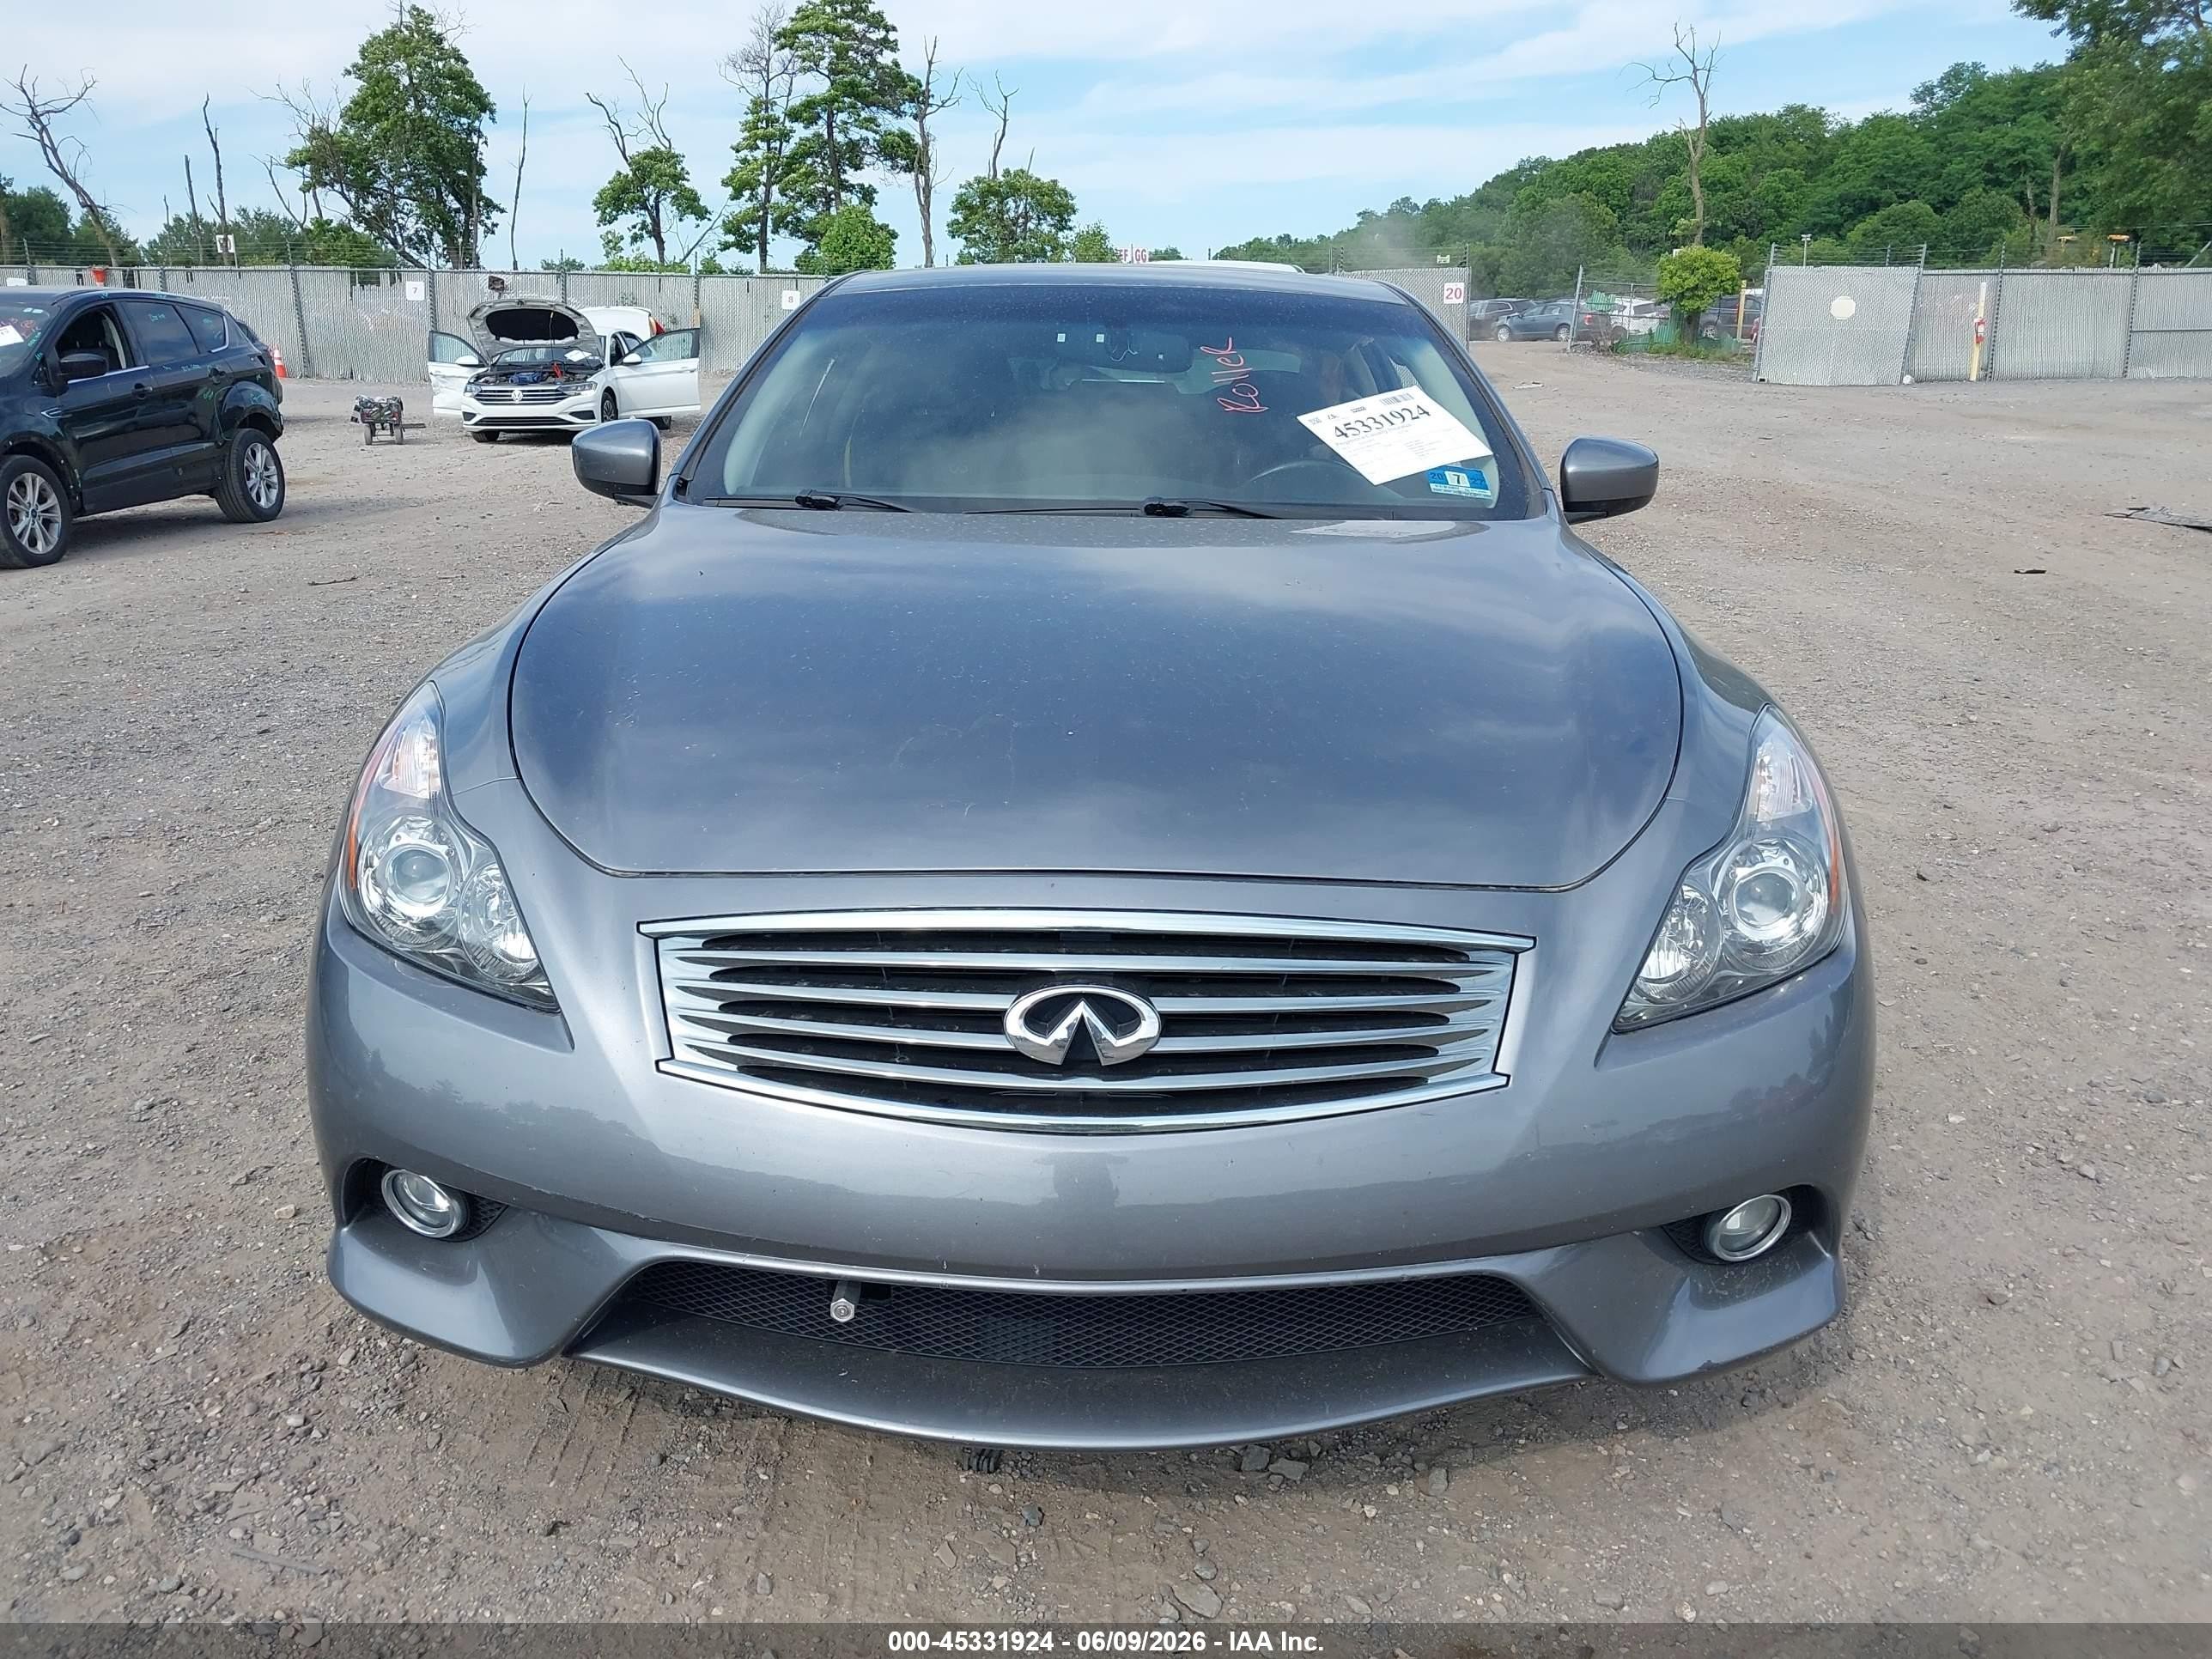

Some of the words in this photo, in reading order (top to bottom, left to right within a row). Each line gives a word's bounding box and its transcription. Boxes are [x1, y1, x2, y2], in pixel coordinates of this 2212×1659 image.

[1134, 248, 1147, 263] GG
[1445, 287, 1462, 300] 20
[1334, 404, 1431, 438] 45331924
[1429, 472, 1444, 481] 20
[1452, 473, 1461, 485] 7
